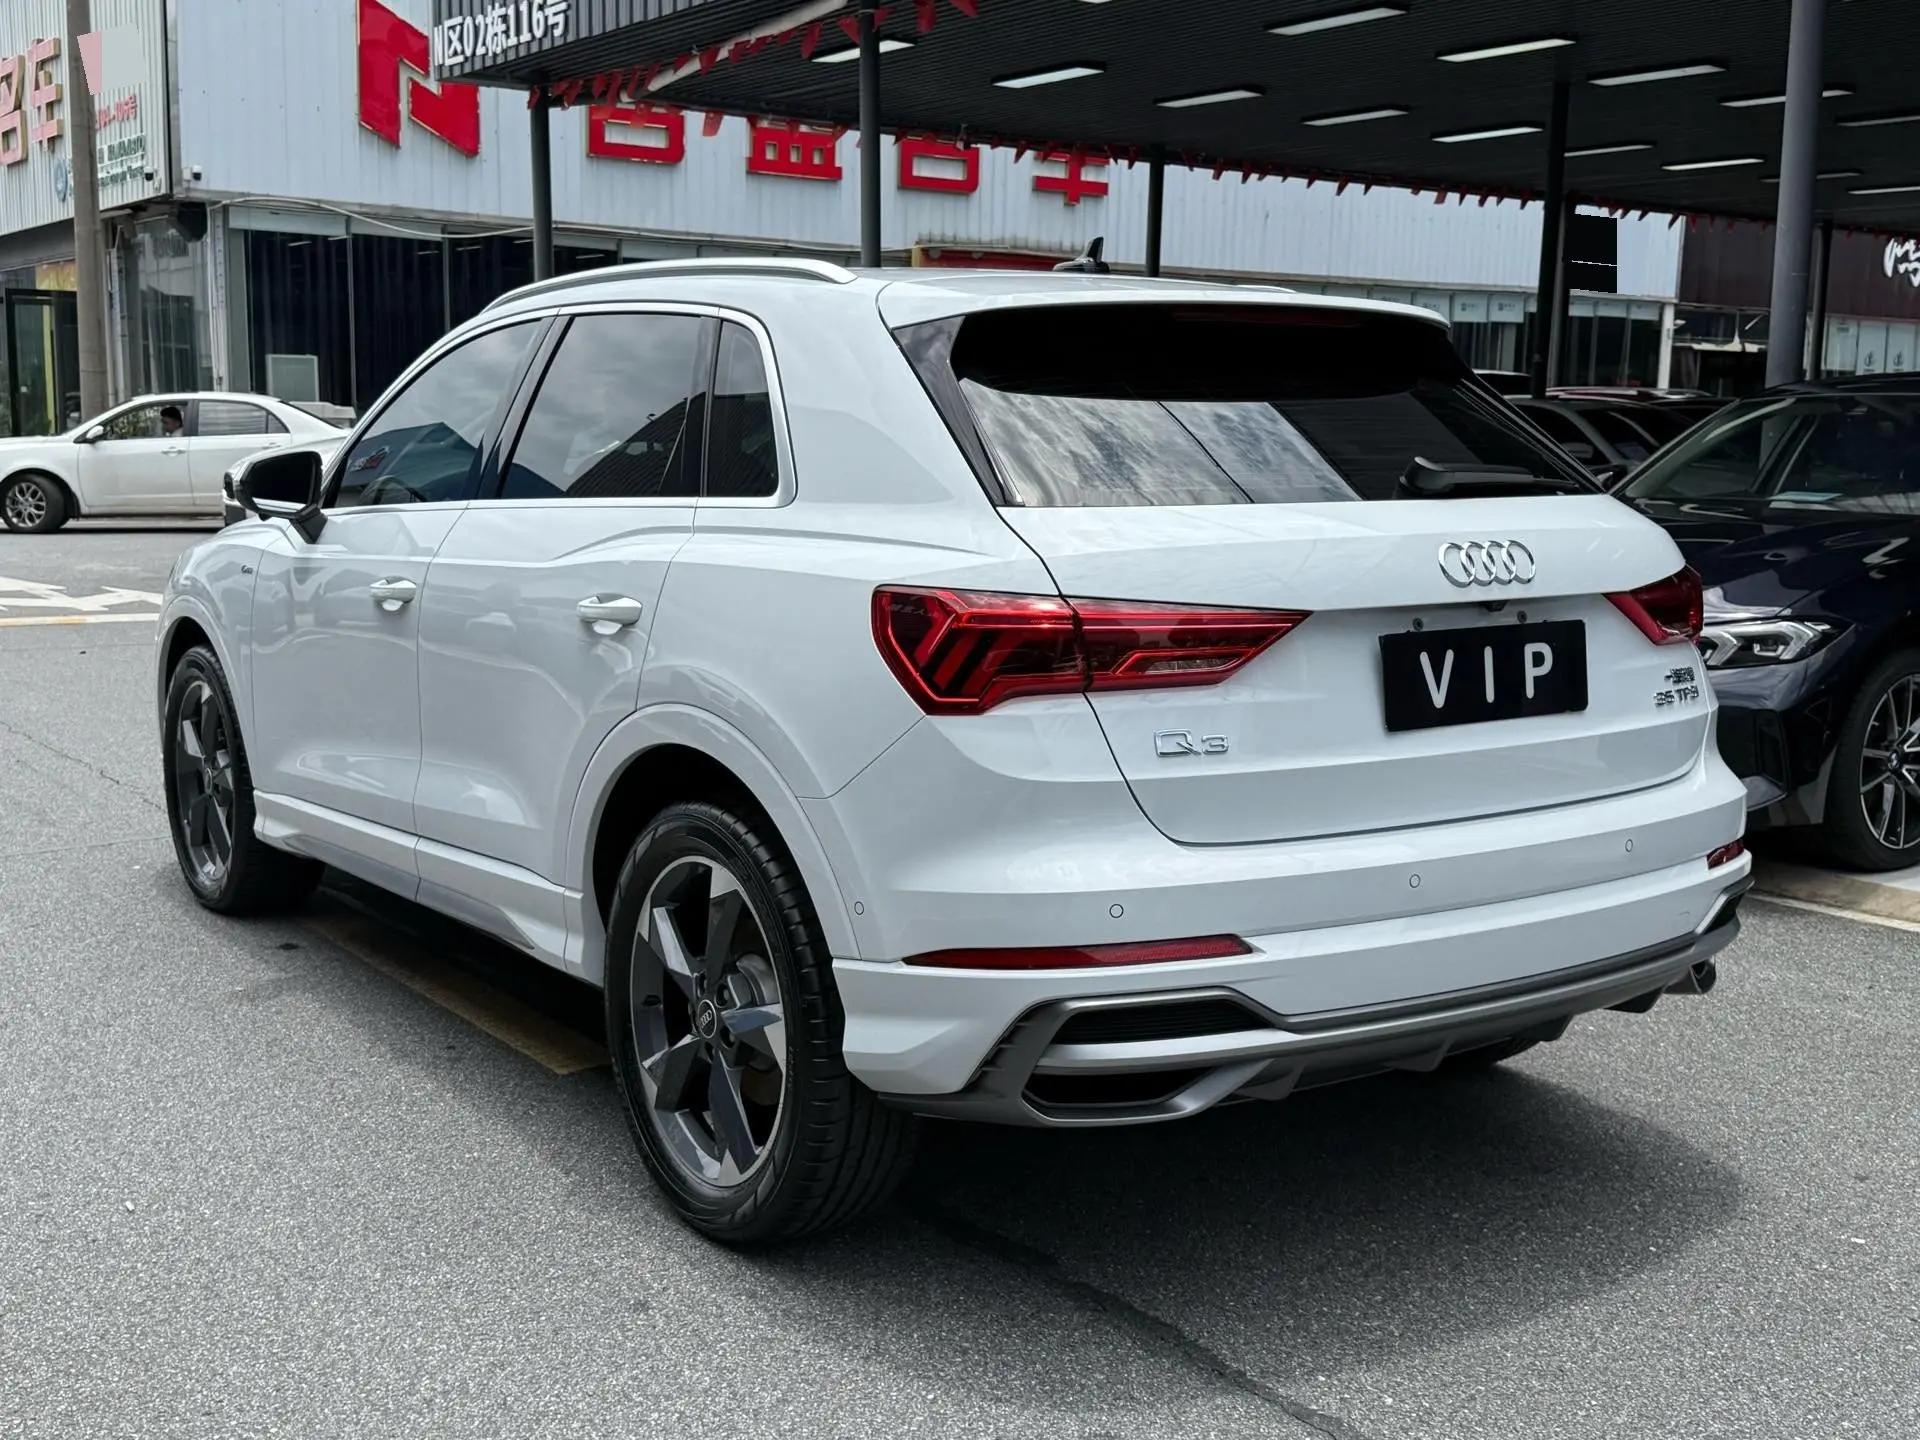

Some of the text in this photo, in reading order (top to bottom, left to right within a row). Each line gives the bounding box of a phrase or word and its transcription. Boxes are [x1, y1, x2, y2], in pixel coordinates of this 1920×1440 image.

[433, 0, 569, 66] N区02栋116号
[1419, 642, 1554, 709] VIP
[1153, 728, 1230, 758] Q3
